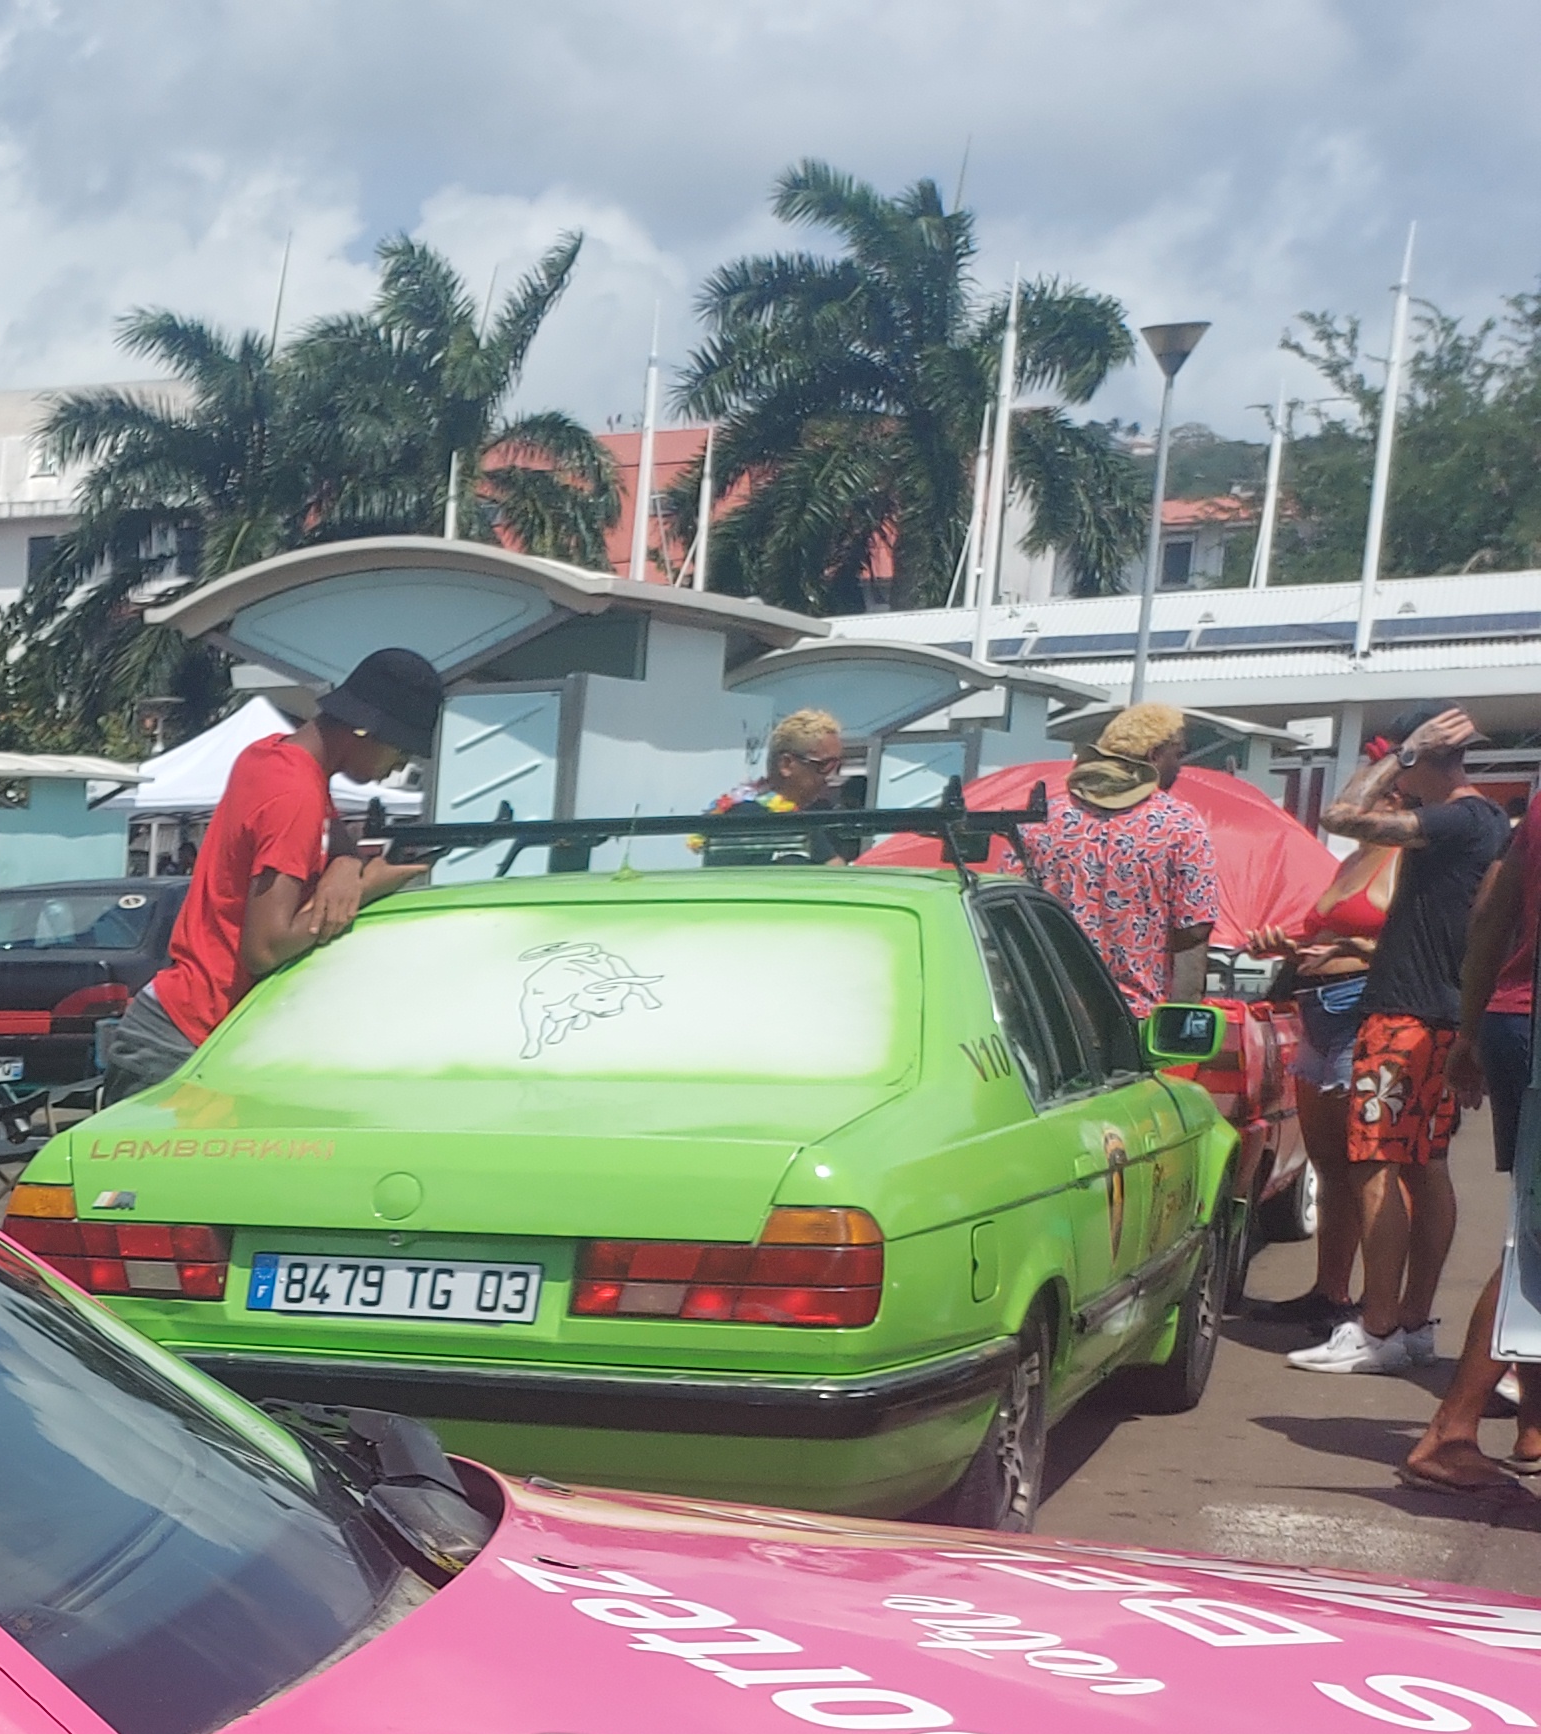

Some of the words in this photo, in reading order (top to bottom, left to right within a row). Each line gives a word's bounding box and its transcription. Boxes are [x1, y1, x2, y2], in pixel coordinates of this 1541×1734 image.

[959, 1034, 1012, 1083] V10
[89, 1138, 336, 1161] LAMBORKIKI
[283, 1262, 385, 1307] 8479
[406, 1266, 455, 1310] TG
[475, 1268, 531, 1314] 03
